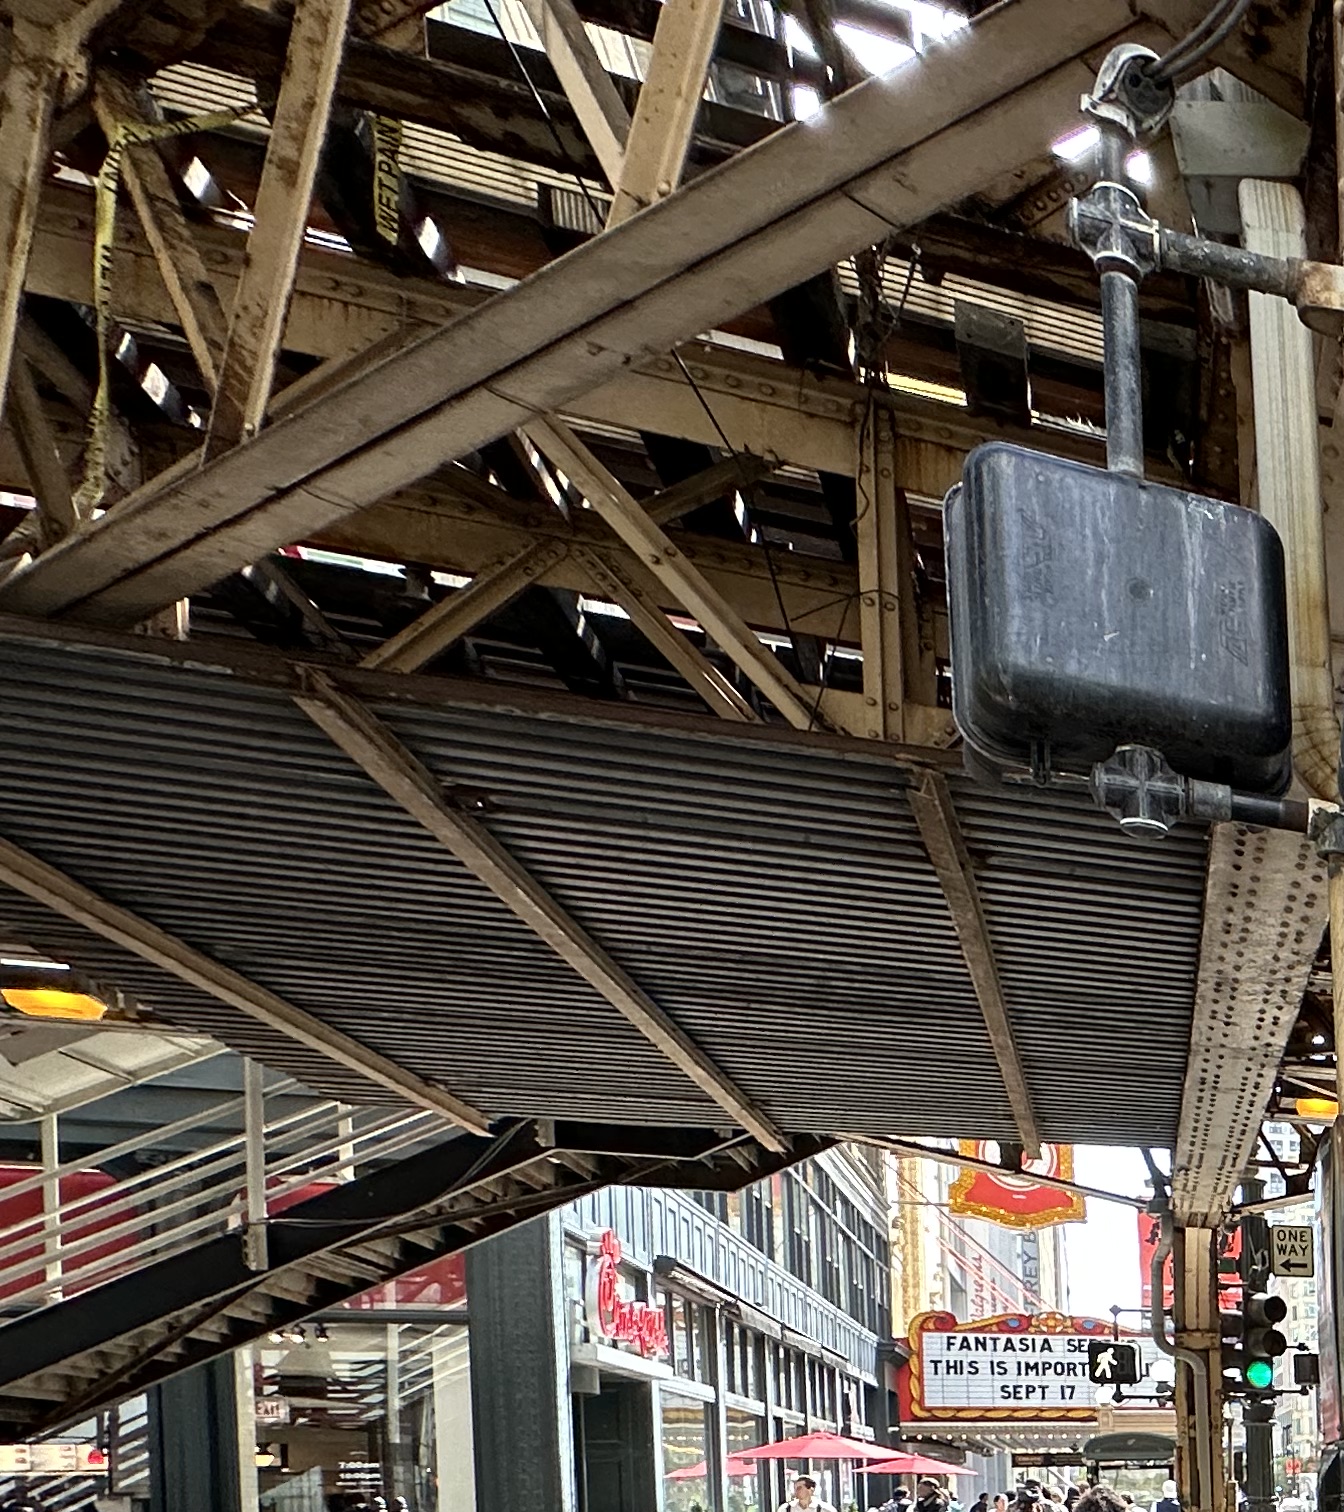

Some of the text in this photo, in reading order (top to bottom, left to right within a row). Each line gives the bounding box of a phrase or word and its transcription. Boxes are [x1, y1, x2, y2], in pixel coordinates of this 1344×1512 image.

[1277, 1229, 1308, 1242] ONE
[1276, 1243, 1309, 1257] WAY
[946, 1335, 1053, 1353] FANTASIA
[929, 1359, 1090, 1377] THIS IS IMPORT
[1000, 1385, 1076, 1400] SEPT 17
